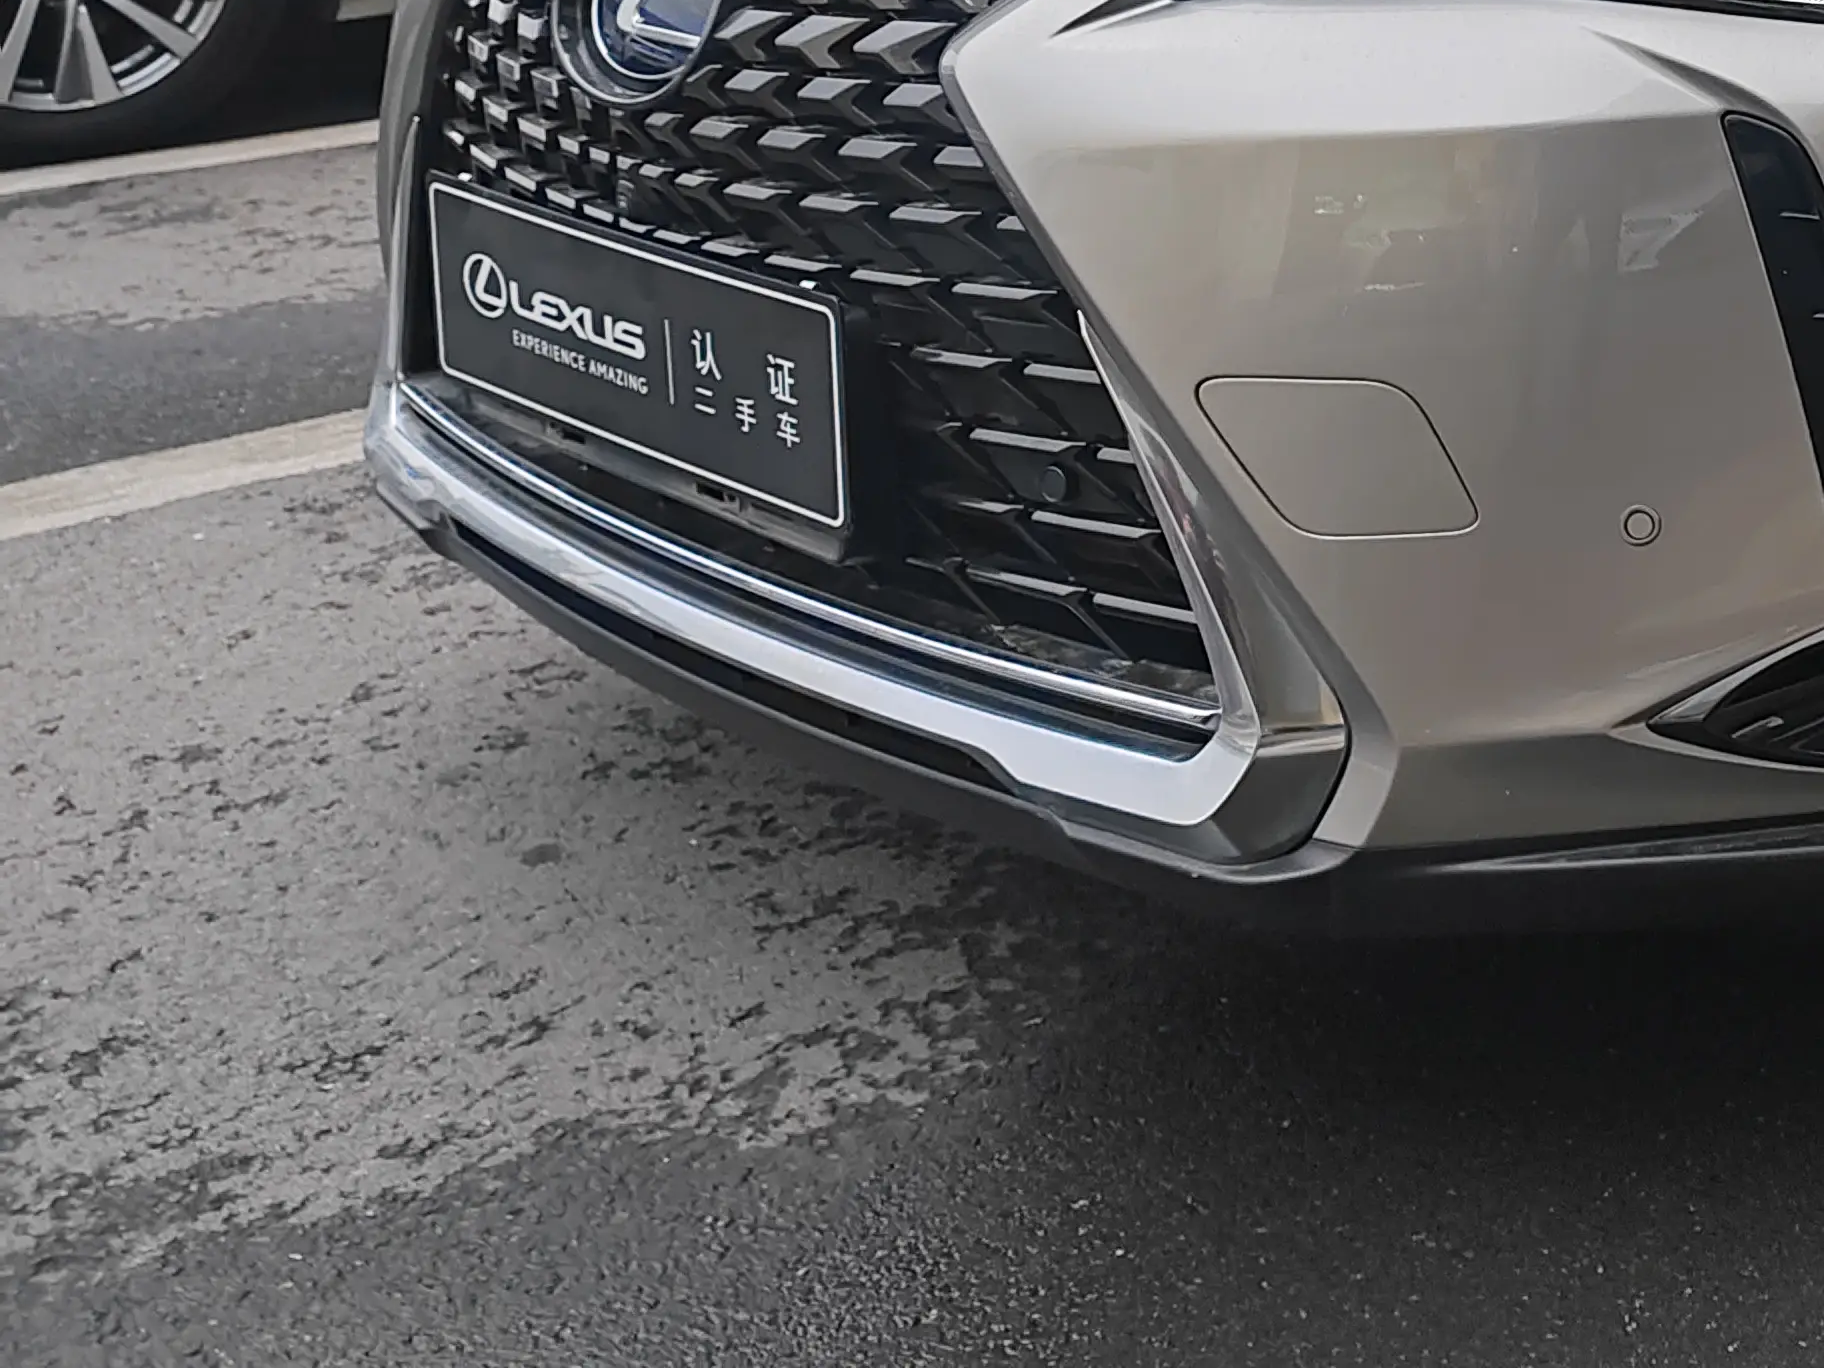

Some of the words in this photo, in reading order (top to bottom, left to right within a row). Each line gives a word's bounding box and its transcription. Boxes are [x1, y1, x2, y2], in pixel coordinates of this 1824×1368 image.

[509, 279, 646, 360] LEXUS
[512, 328, 586, 372] EXPERIENCE
[588, 358, 649, 395] AMAZING
